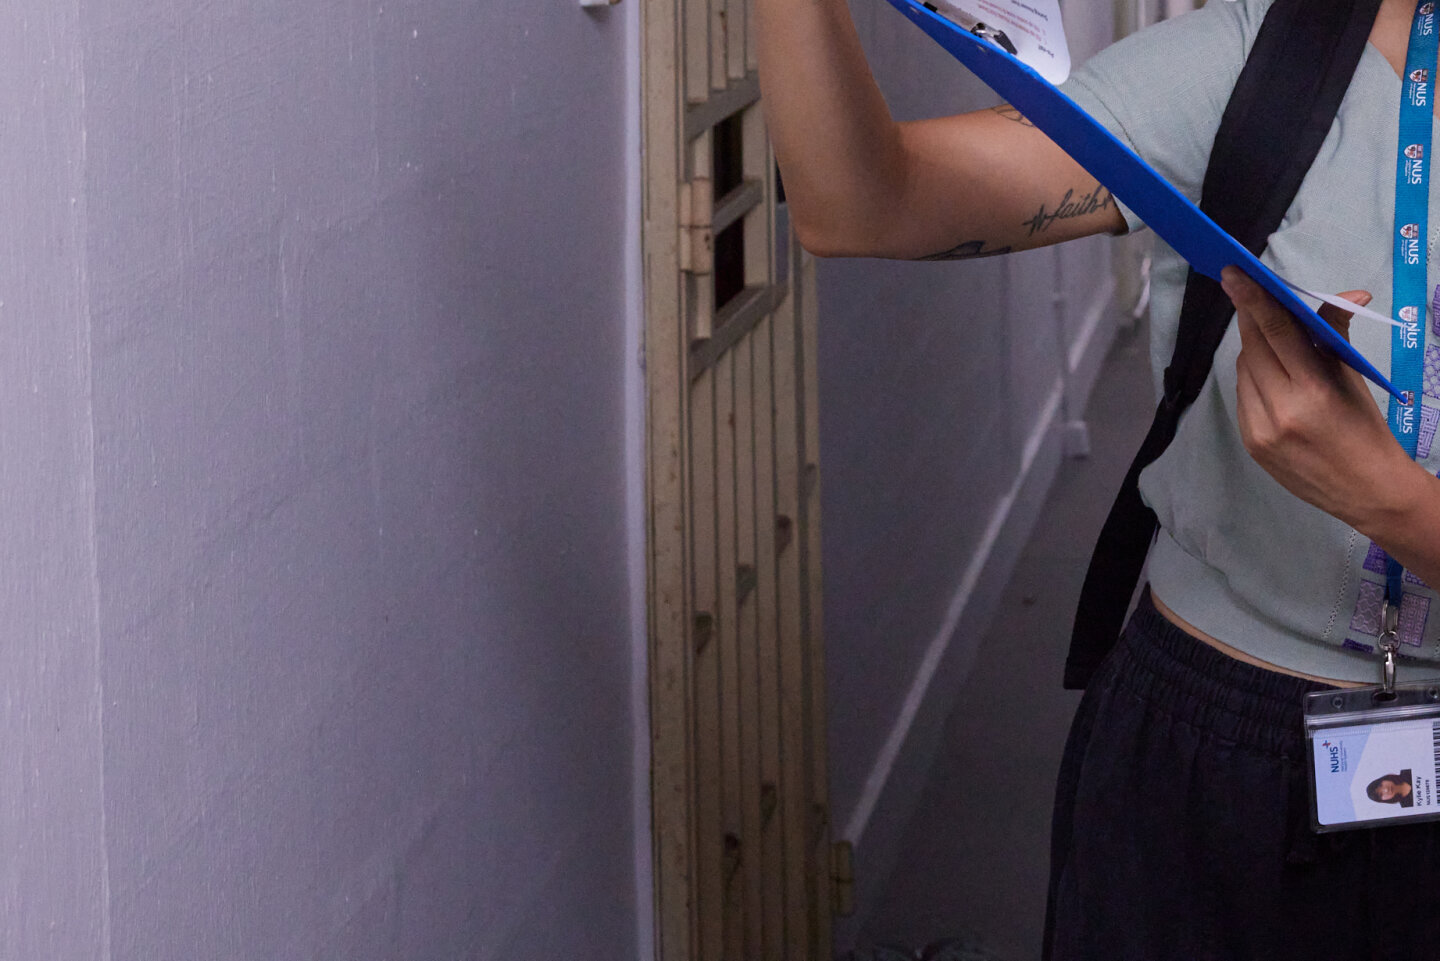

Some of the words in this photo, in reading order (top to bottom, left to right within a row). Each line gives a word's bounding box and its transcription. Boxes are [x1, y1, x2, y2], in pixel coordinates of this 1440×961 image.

[1424, 13, 1432, 35] NUS
[1416, 82, 1426, 106] NUS
[1412, 160, 1422, 184] NUS
[1408, 239, 1418, 265] NUS
[1407, 322, 1417, 349] NUS
[1402, 407, 1413, 434] NUS
[1330, 746, 1339, 772] NUHS
